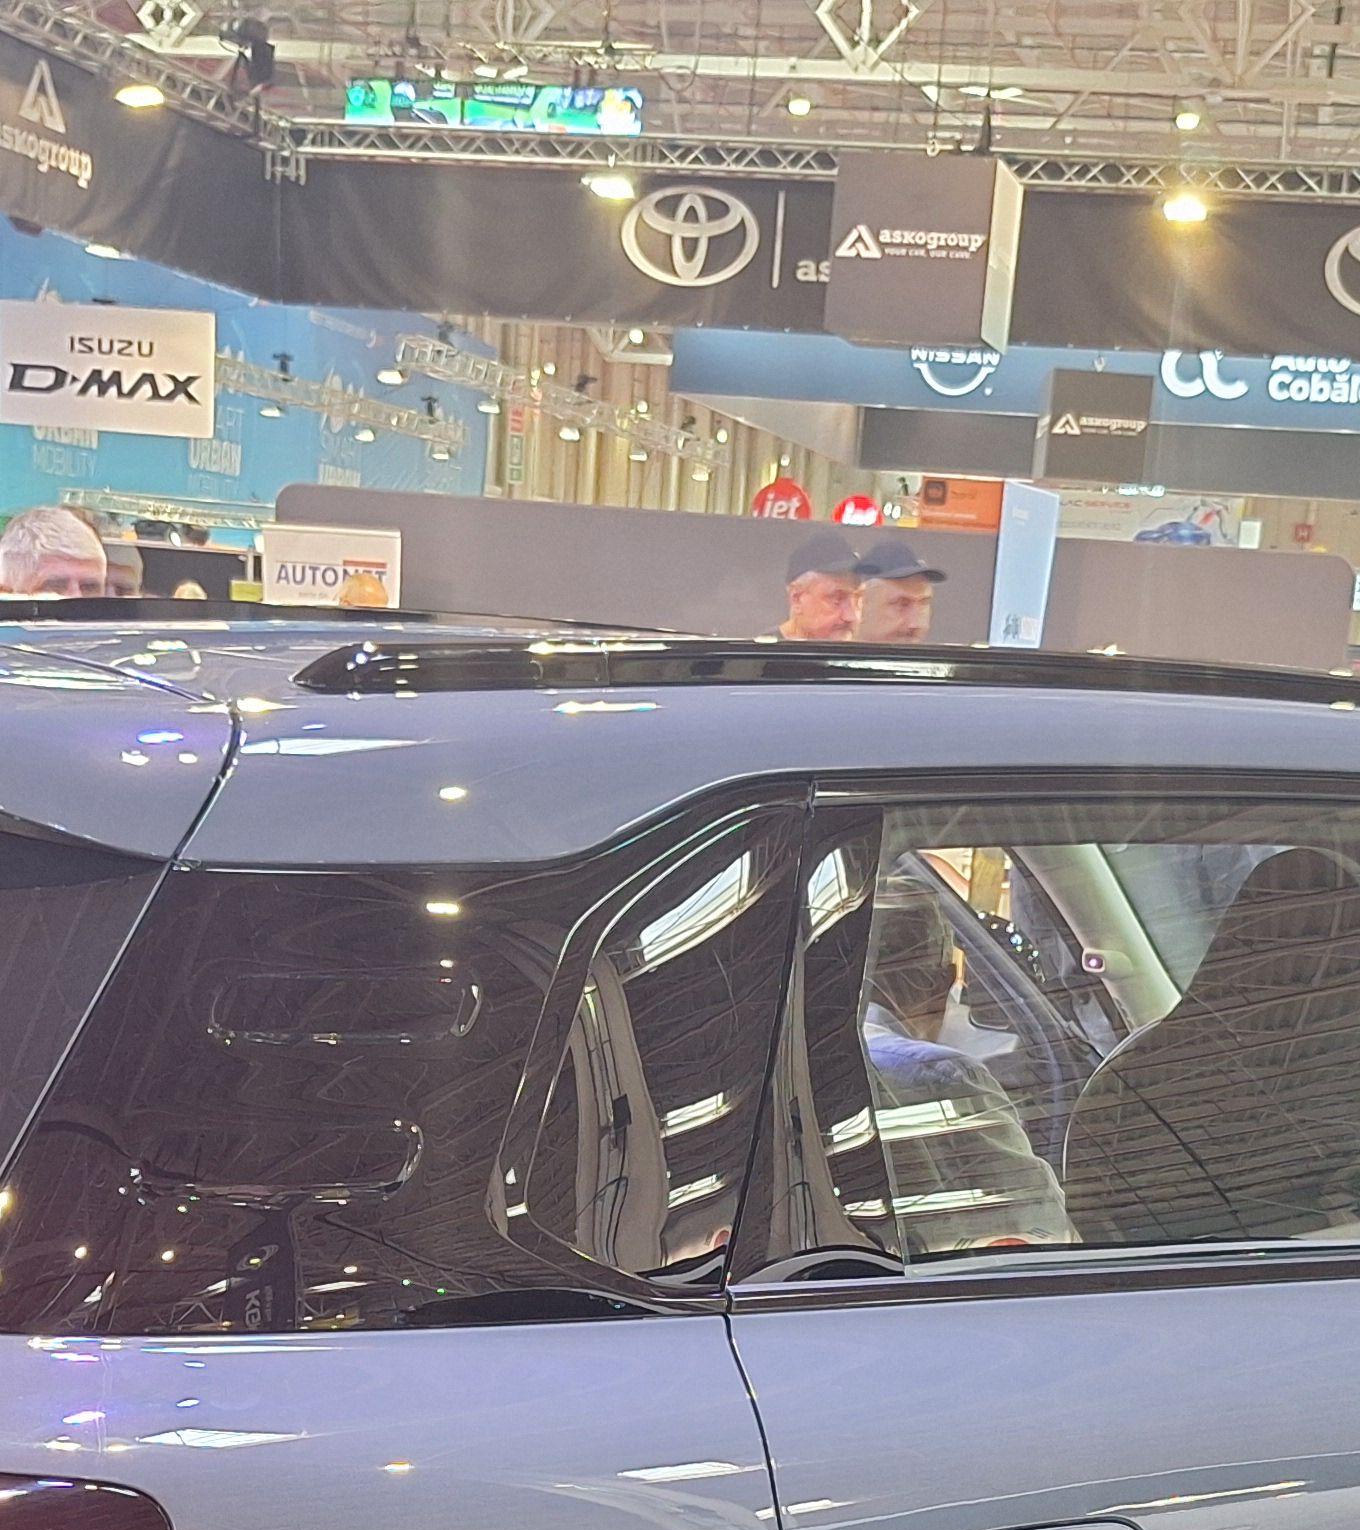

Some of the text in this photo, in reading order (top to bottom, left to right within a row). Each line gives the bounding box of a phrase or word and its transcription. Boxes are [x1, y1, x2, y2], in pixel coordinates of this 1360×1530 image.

[878, 229, 986, 252] askogroup
[68, 335, 155, 358] ISUZU
[910, 347, 1001, 366] NISSAN
[275, 563, 388, 588] AUTOT
